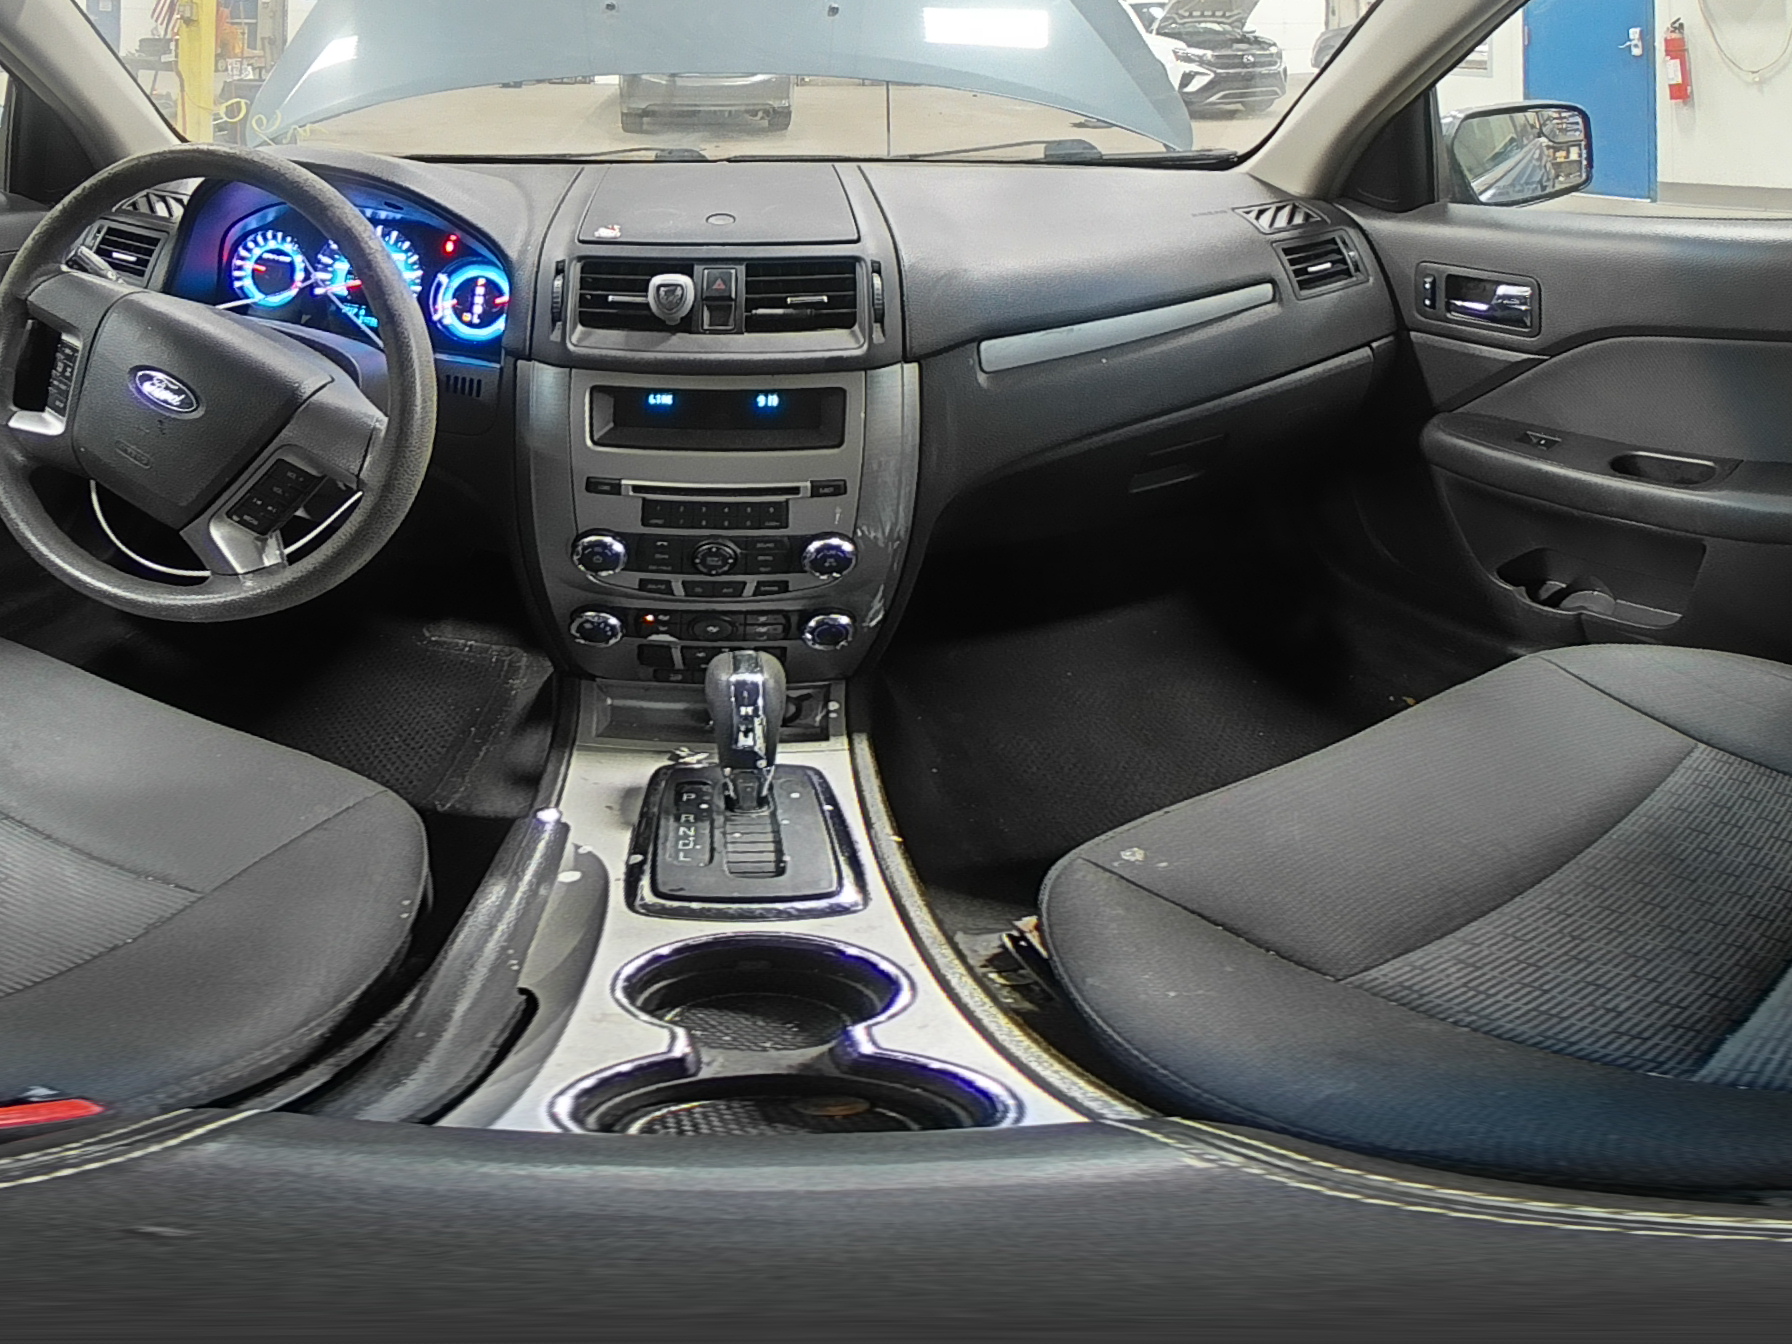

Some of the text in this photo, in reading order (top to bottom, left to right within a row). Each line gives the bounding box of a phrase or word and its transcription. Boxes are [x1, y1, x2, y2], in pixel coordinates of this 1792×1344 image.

[142, 375, 186, 406] Ford
[682, 792, 696, 802] P
[680, 813, 695, 824] R
[678, 826, 696, 836] N
[678, 851, 692, 862] L
